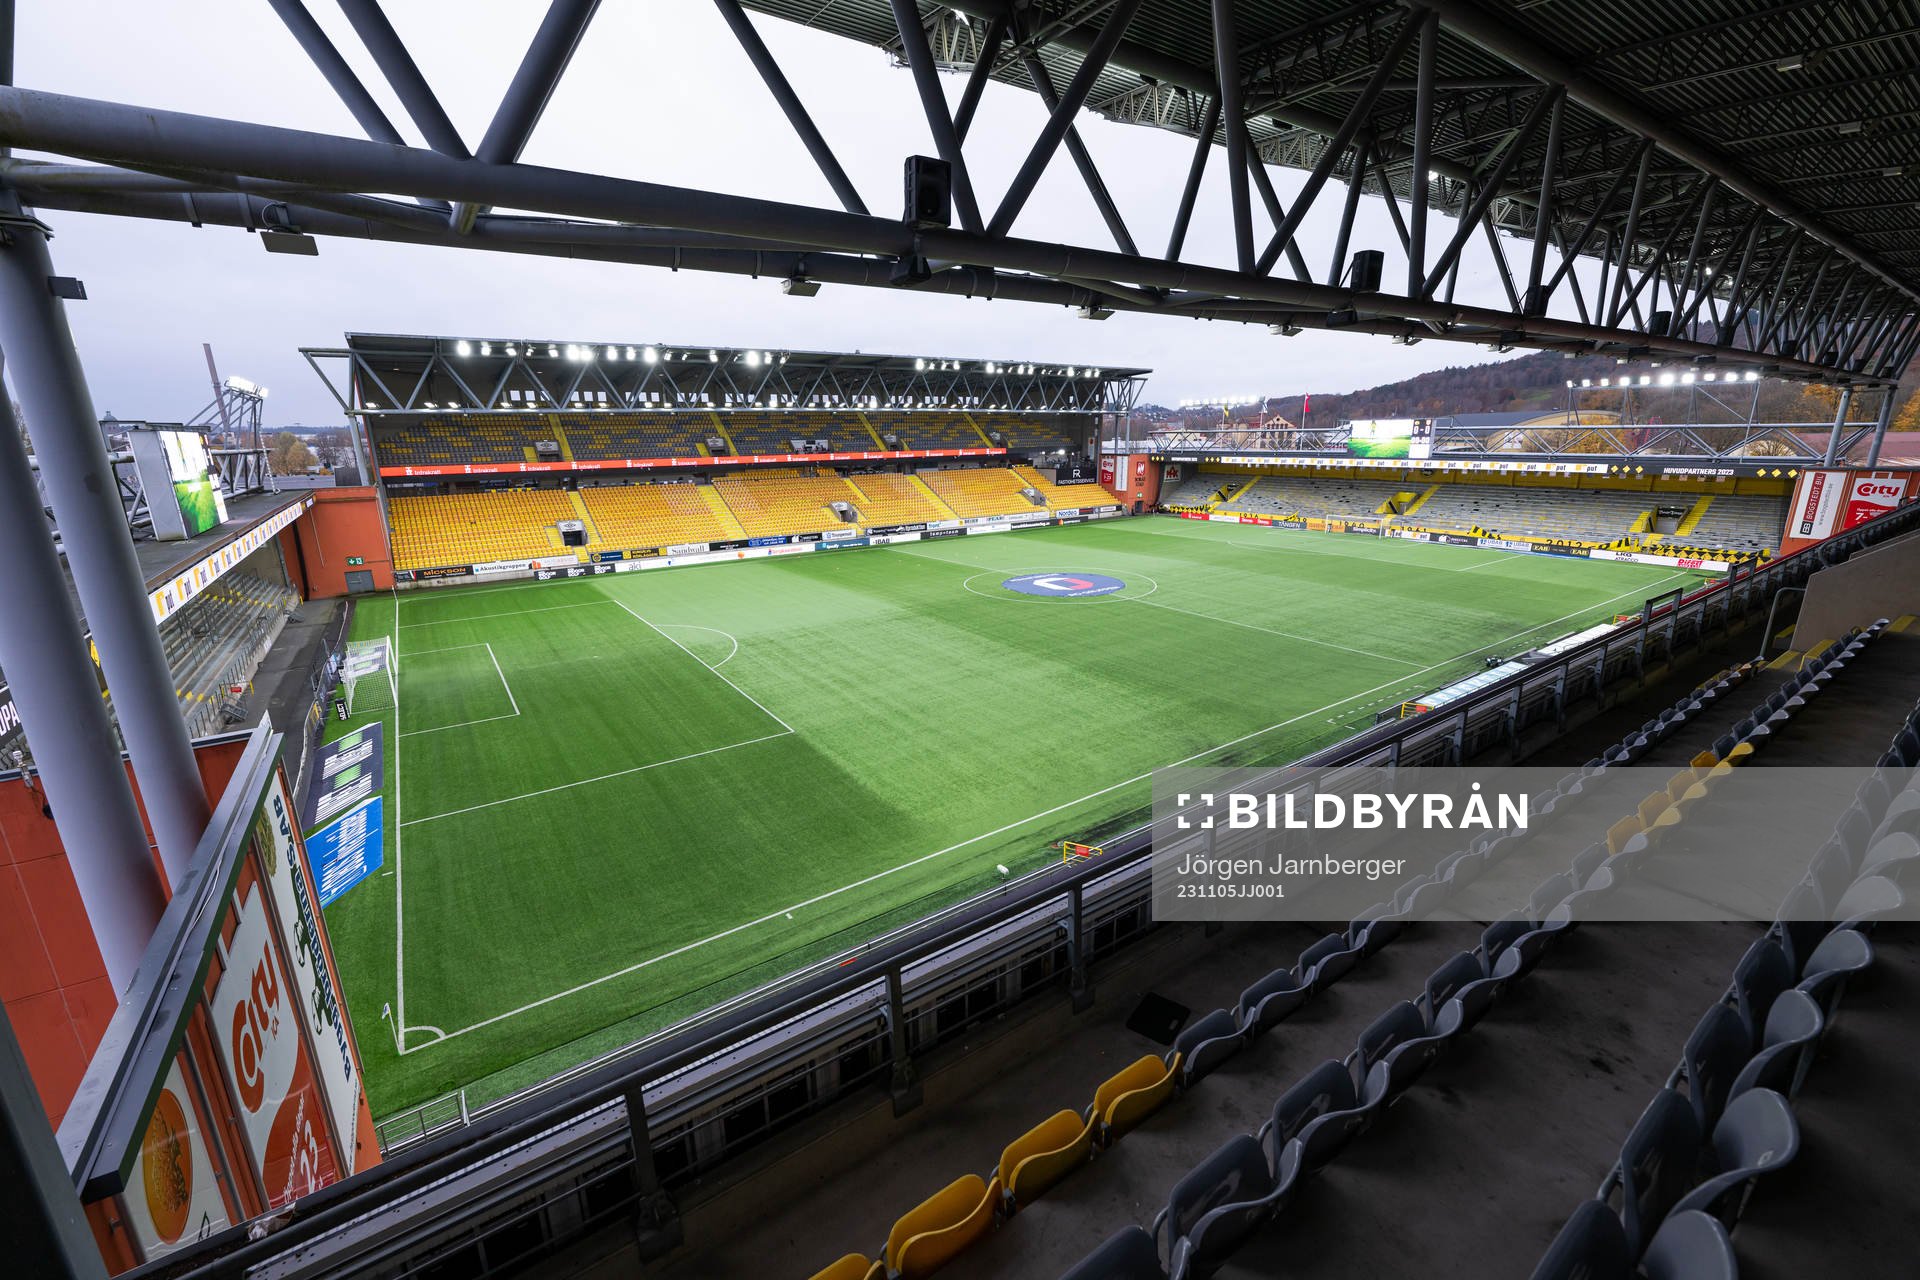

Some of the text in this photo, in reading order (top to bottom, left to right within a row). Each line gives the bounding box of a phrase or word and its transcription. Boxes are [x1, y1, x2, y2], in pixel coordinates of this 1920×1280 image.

[1806, 486, 1822, 520] BOGSTEDT
[1857, 483, 1900, 496] City
[273, 794, 290, 836] AB
[232, 941, 280, 1114] City
